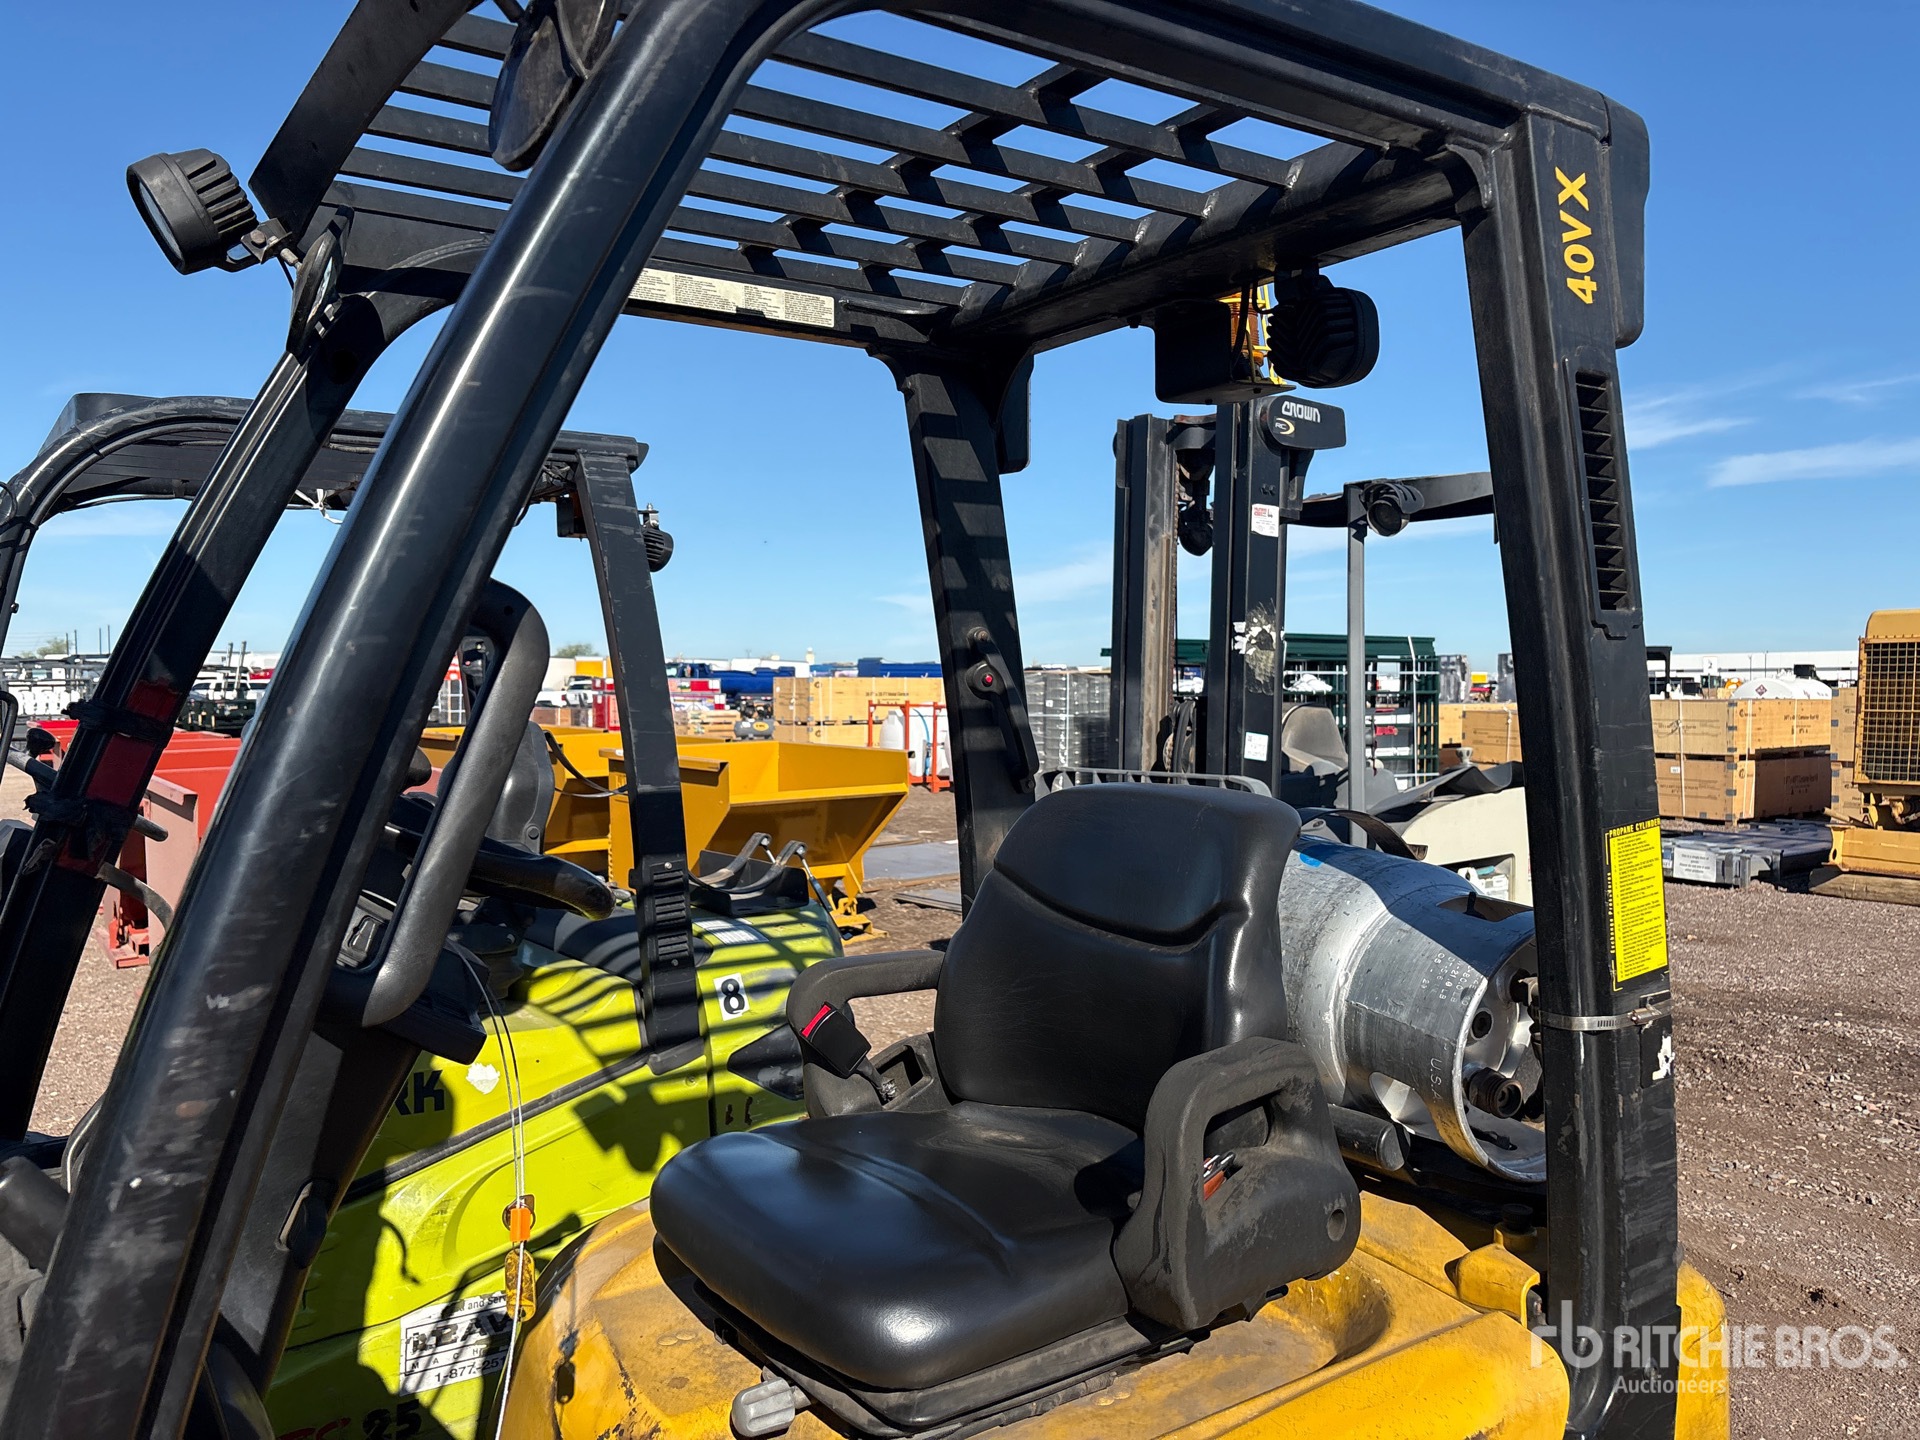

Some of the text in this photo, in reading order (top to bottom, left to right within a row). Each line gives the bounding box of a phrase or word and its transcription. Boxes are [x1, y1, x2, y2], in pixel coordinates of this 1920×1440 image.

[1555, 166, 1597, 304] 40VX
[1609, 825, 1634, 838] PROPANE
[720, 978, 746, 1015] 8
